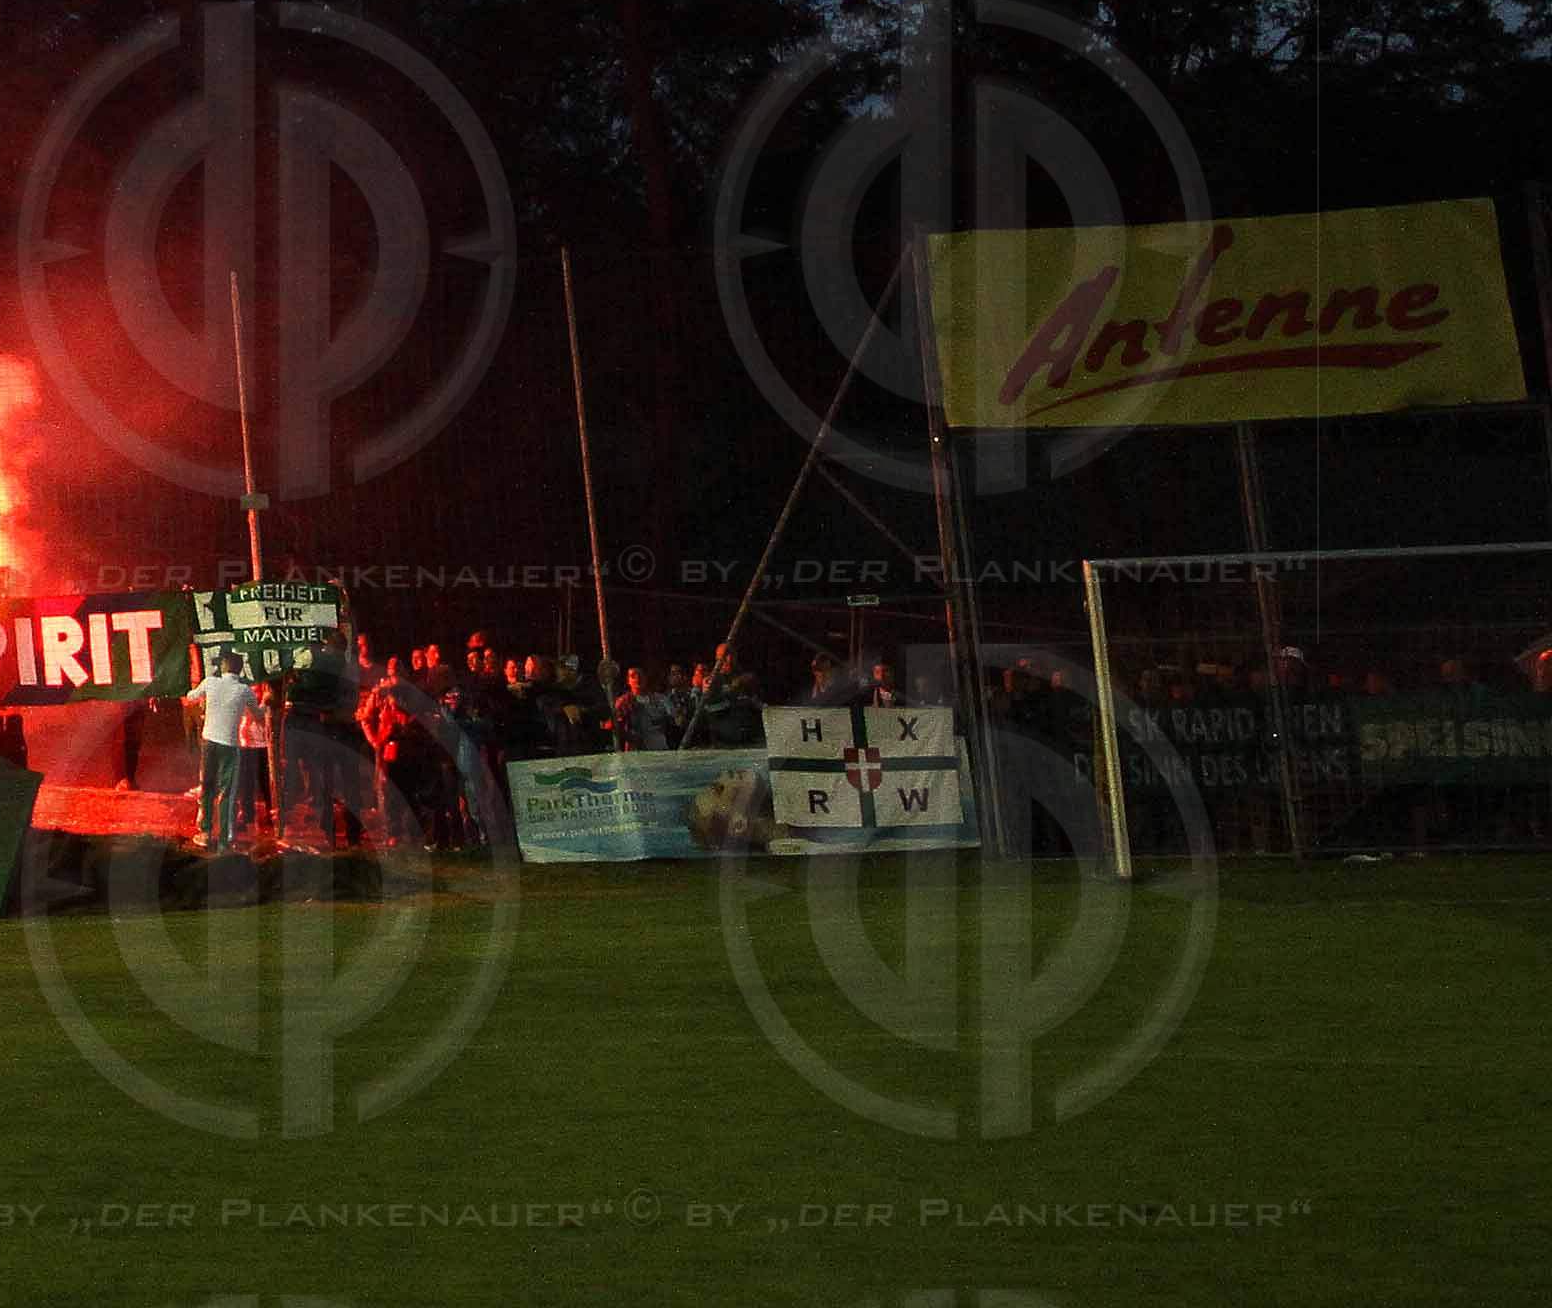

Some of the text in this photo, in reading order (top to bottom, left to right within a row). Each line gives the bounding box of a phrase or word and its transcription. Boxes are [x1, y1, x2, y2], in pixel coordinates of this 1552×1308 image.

[997, 225, 1449, 404] Antenne
[240, 584, 327, 602] FREIHEIT
[265, 604, 302, 621] FÜR
